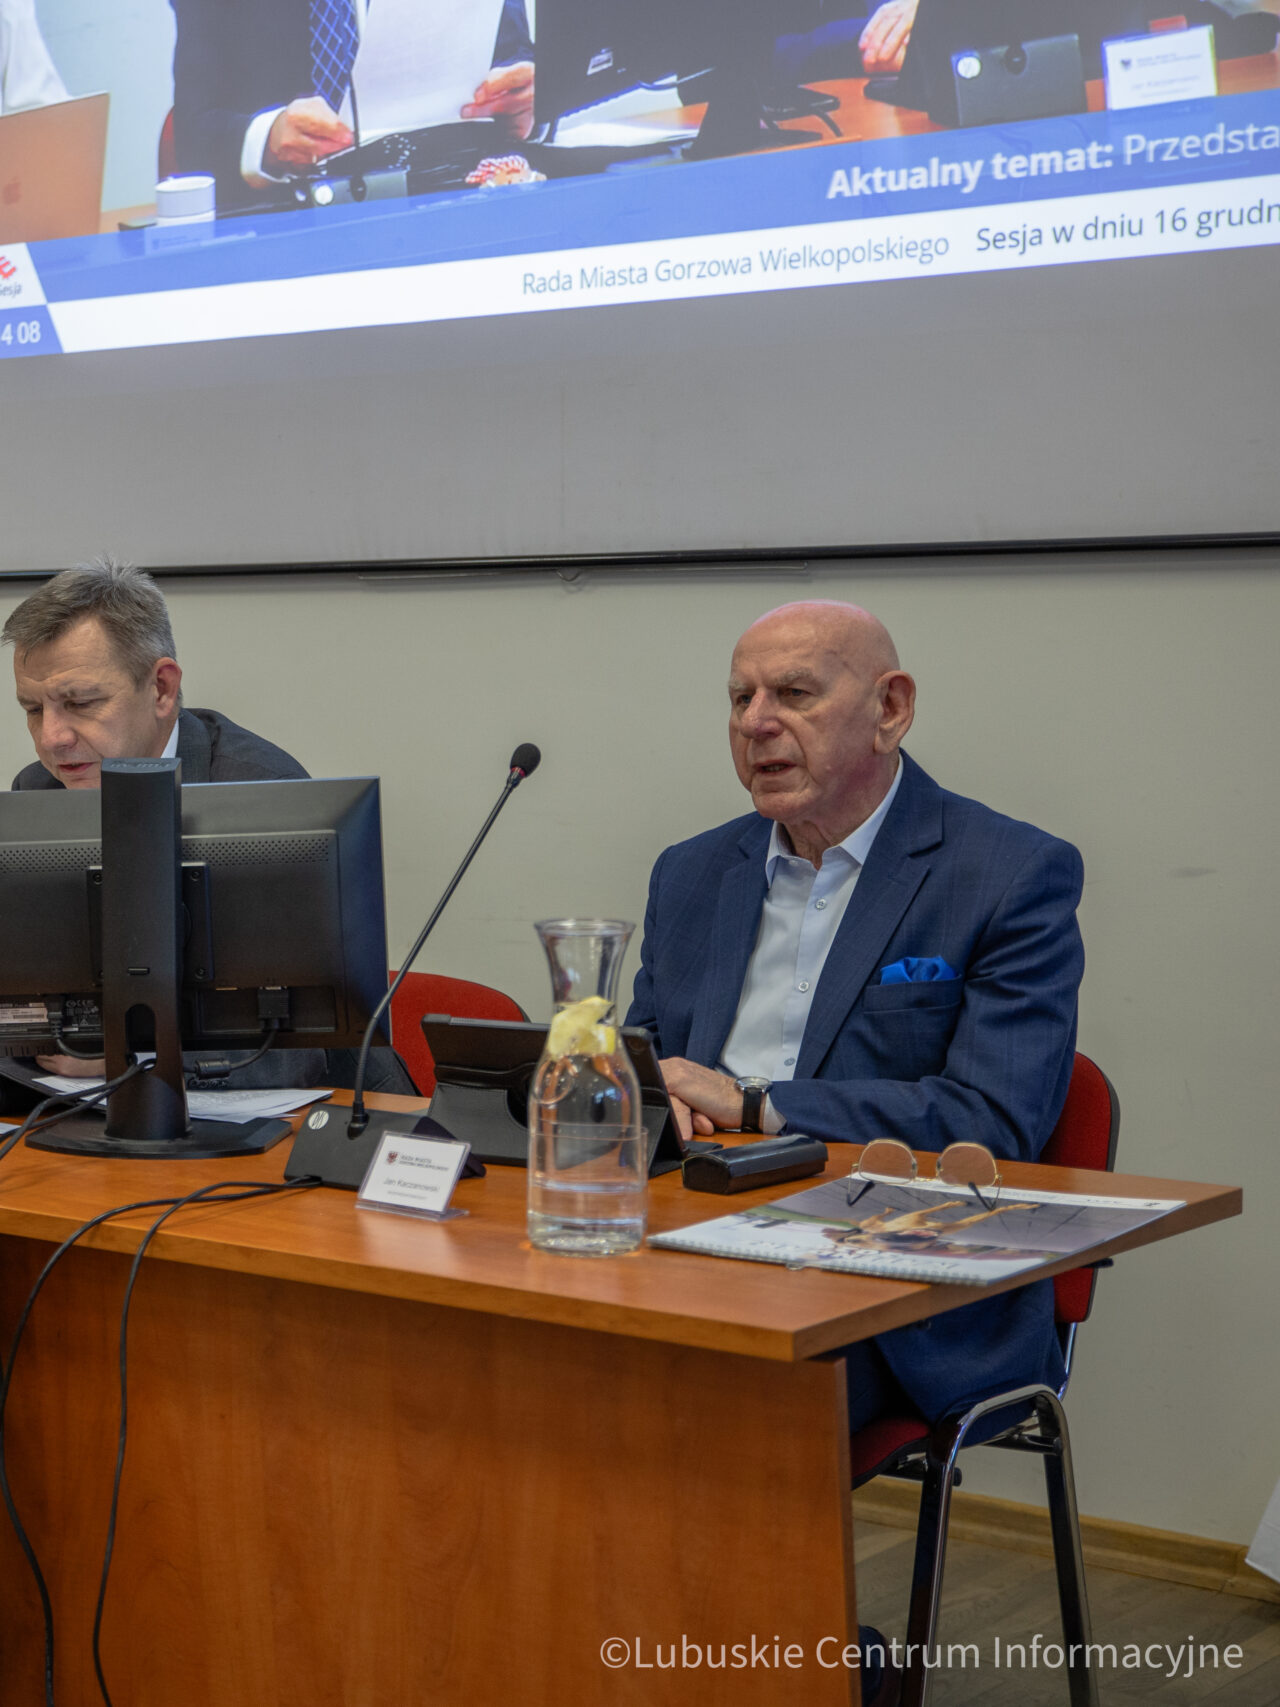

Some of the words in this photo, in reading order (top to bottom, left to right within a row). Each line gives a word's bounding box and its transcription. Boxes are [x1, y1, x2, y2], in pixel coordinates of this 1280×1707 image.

[826, 157, 984, 199] Aktualny
[991, 140, 1114, 180] temat:
[1123, 122, 1280, 166] Przedsta
[976, 223, 1043, 256] Sesja
[1052, 224, 1075, 244] w
[1083, 215, 1143, 241] dniu
[1155, 207, 1188, 235] 16
[1196, 198, 1280, 239] grudn
[523, 270, 573, 295] Rada
[580, 264, 648, 290] Miasta
[655, 256, 752, 283] Gorzowa
[760, 235, 950, 273] Wielkopolskiego
